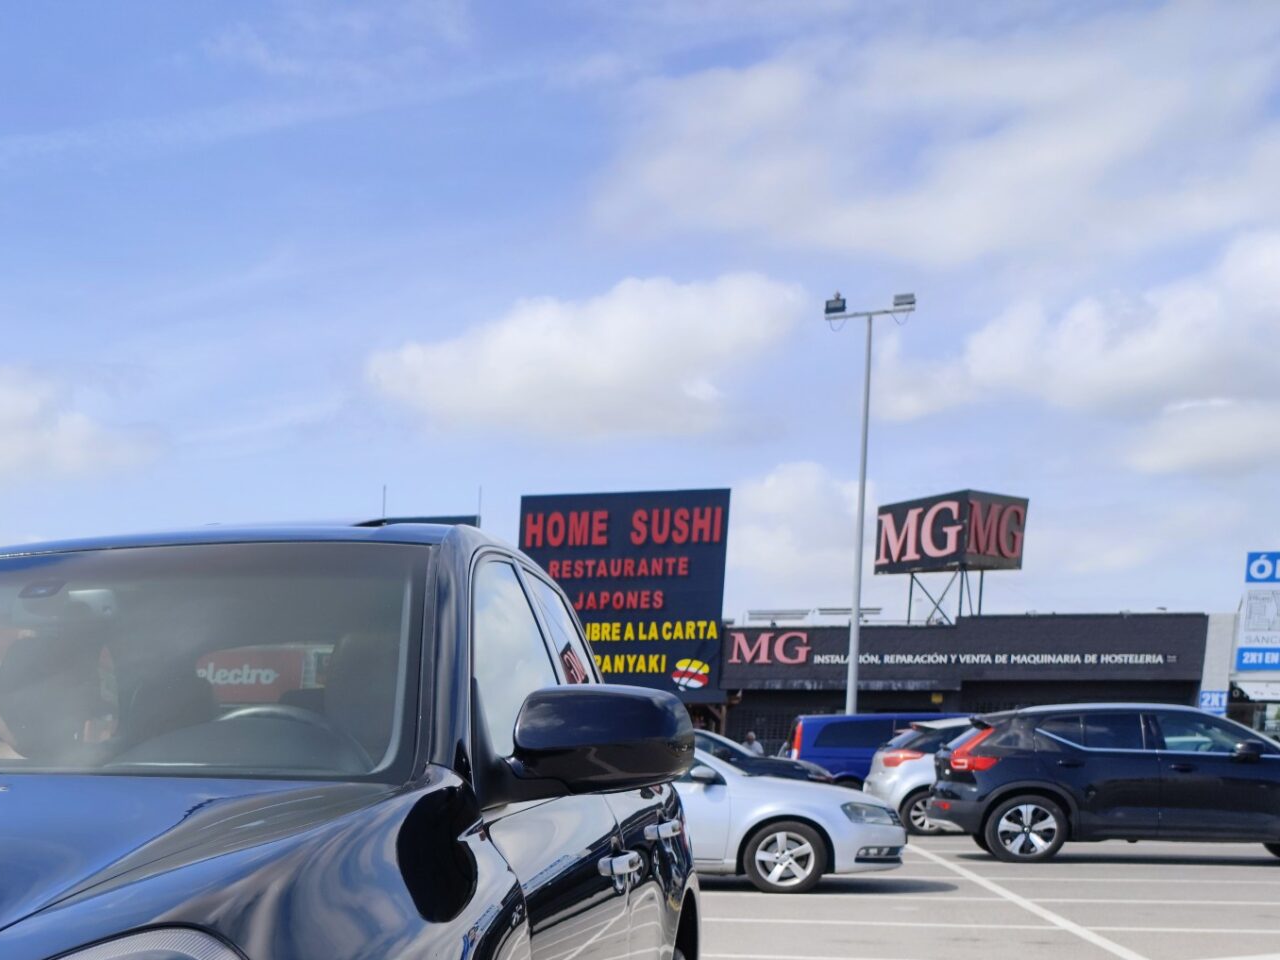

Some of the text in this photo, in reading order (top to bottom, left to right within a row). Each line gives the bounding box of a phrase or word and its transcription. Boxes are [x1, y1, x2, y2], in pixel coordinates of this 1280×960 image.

[525, 507, 723, 547] HOME SUSHI
[875, 501, 962, 565] MG
[966, 500, 1025, 558] MG
[548, 557, 689, 579] RESTAURANTE
[574, 590, 664, 611] JAPONES
[586, 620, 718, 641] IBRE A LA CARTA
[728, 631, 811, 666] MG
[884, 652, 947, 665] REPARACIÓN
[950, 654, 957, 664] Y
[959, 654, 992, 664] VENTA
[995, 654, 1007, 664] DE
[1011, 654, 1081, 664] MAQUINARIA
[1084, 654, 1097, 664] DE
